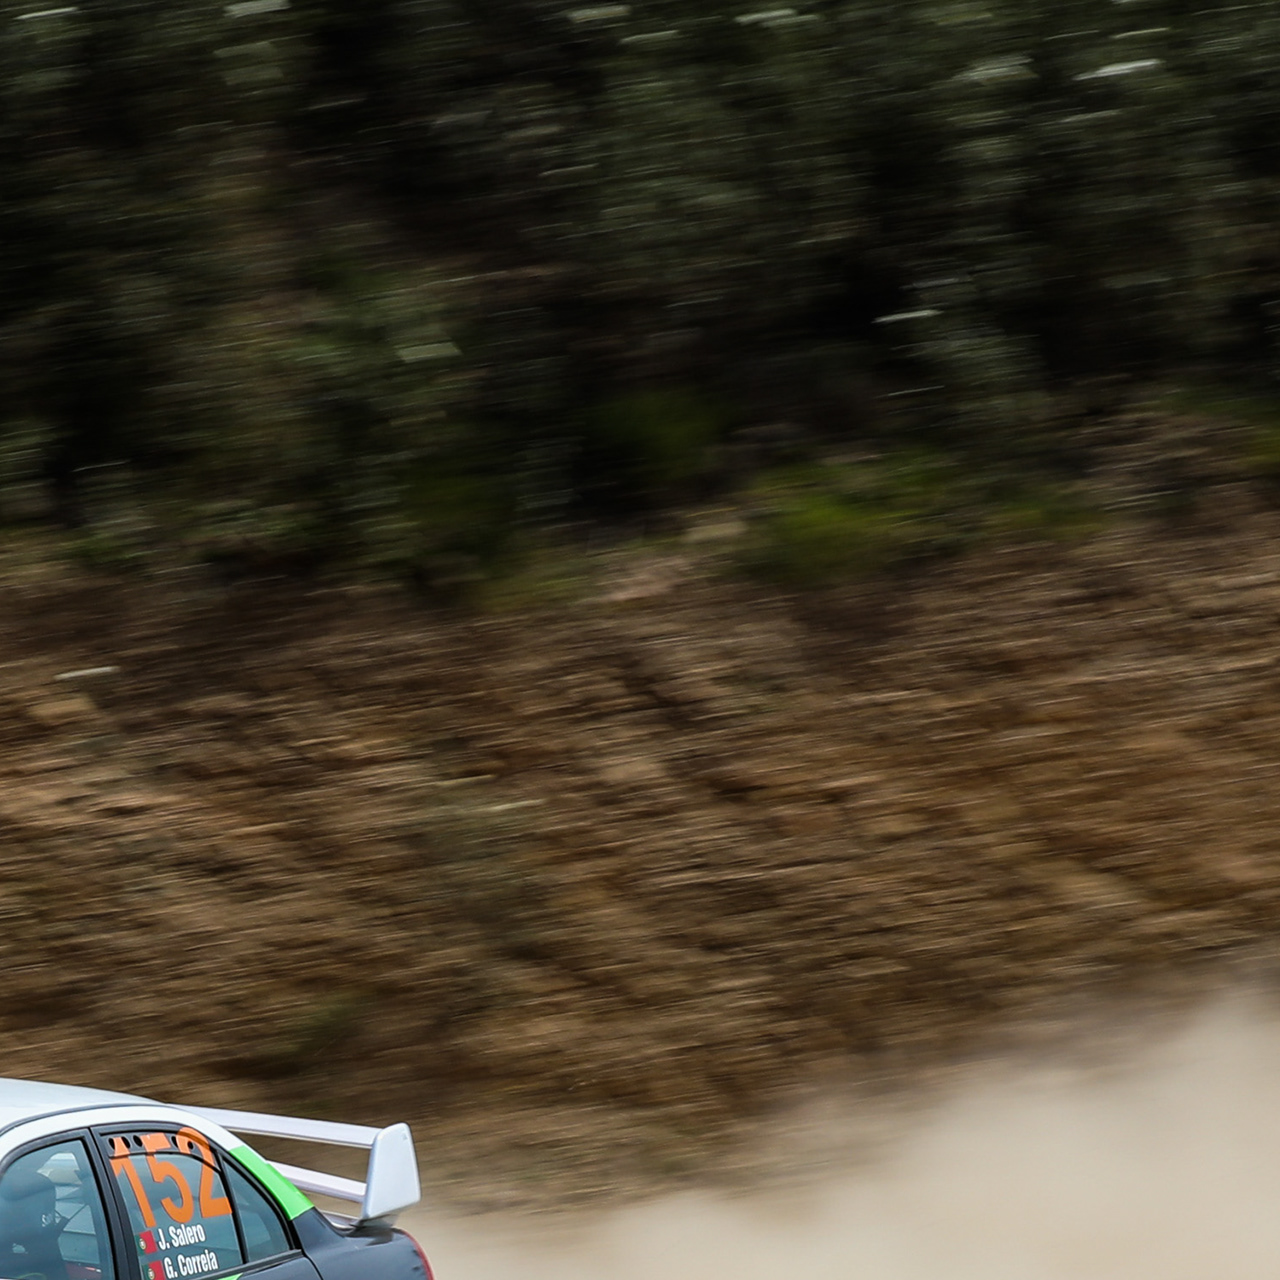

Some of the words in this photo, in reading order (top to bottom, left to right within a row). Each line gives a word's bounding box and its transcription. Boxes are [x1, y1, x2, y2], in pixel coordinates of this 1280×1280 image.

[109, 1127, 232, 1228] 152
[158, 1228, 170, 1250] J.
[169, 1224, 206, 1249] Salero
[164, 1257, 178, 1280] G.
